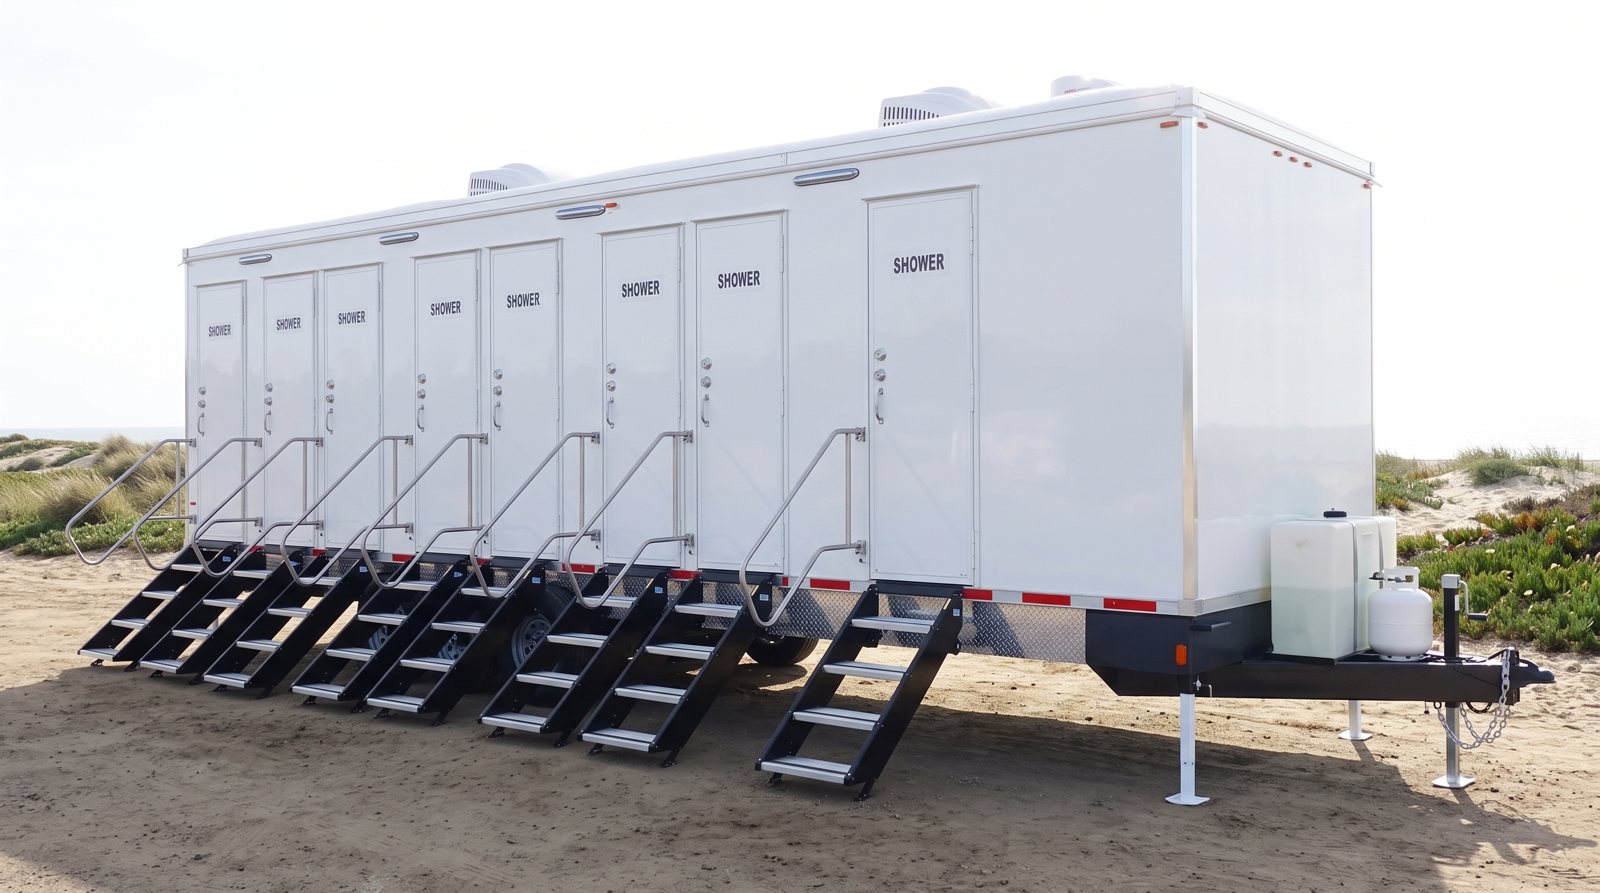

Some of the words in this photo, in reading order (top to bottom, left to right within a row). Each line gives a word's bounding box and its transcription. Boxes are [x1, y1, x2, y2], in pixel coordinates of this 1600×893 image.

[893, 253, 945, 275] SHOWER
[717, 270, 761, 290] SHOWER
[621, 280, 660, 298] SHOWER
[430, 300, 462, 317] SHOWER
[506, 292, 540, 309] SHOWER
[276, 316, 302, 330] SHOWER
[337, 310, 365, 326] SHOWER
[208, 324, 232, 337] SHOWER
